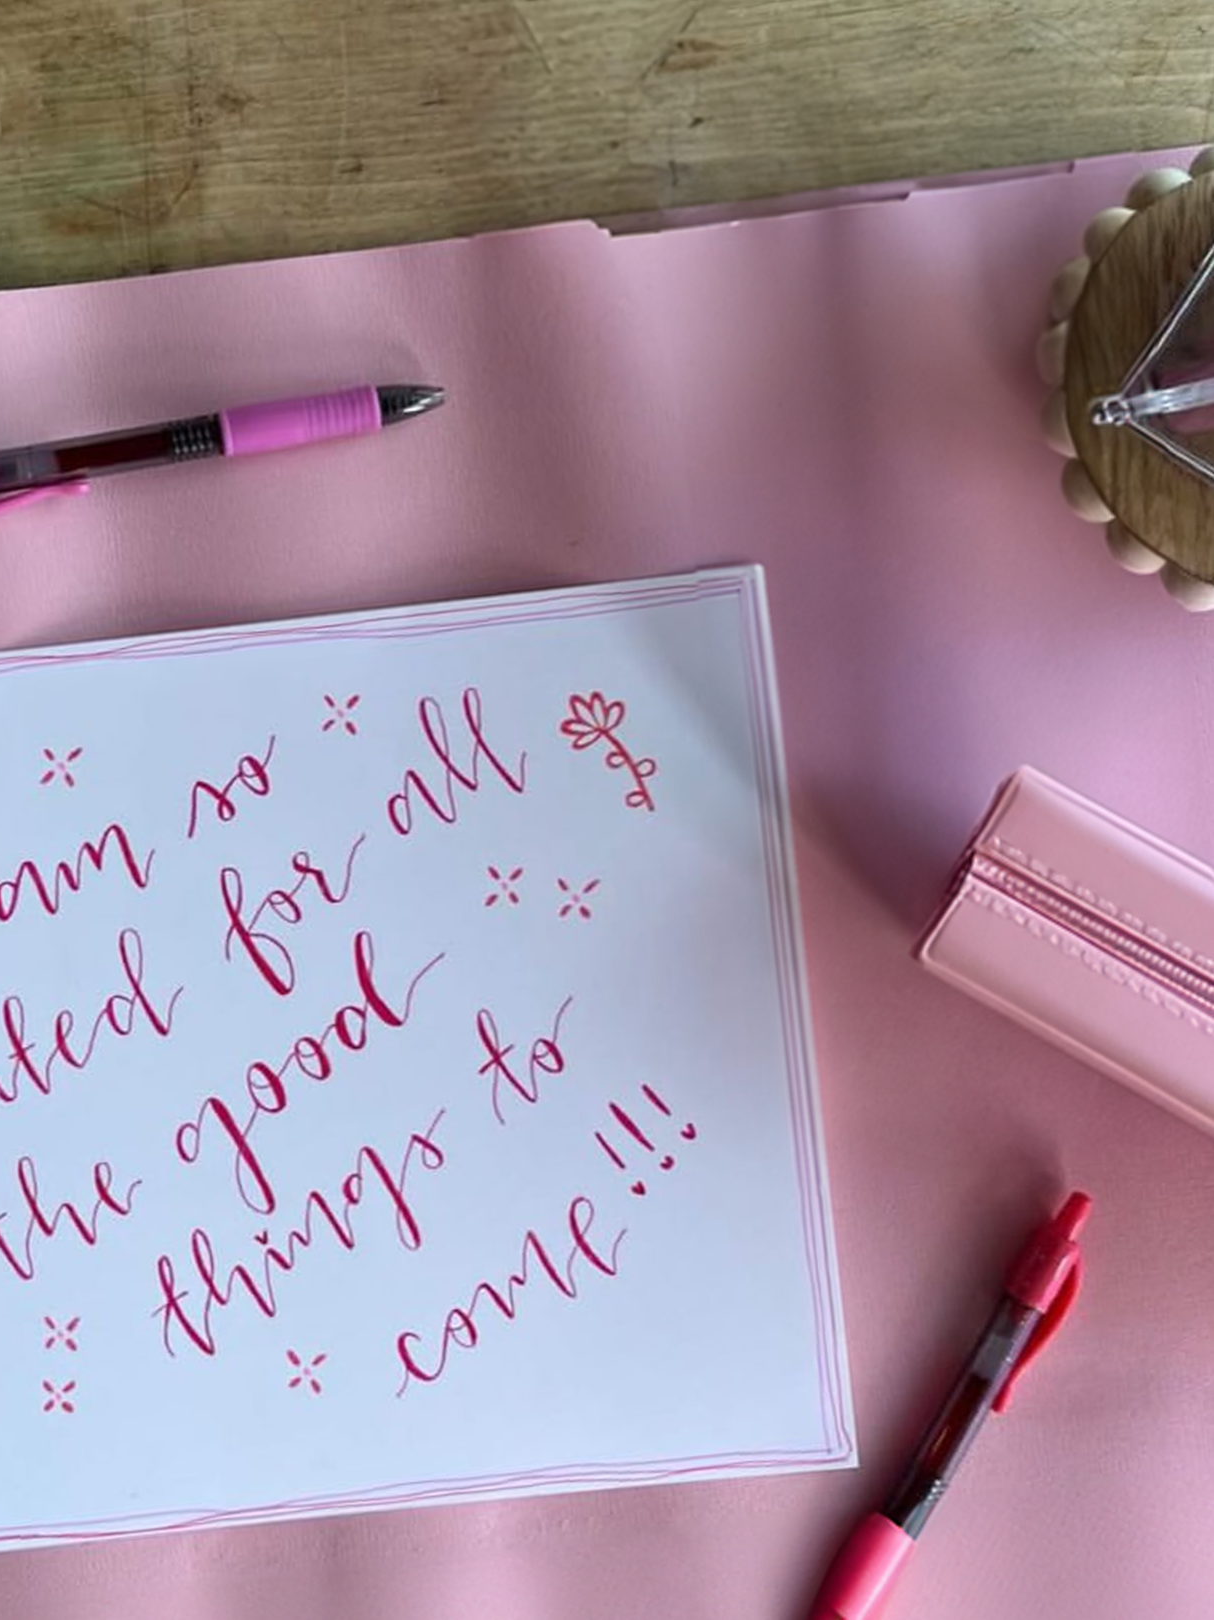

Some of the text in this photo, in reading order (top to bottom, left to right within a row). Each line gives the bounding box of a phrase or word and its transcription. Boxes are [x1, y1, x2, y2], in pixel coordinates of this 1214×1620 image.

[187, 735, 276, 839] so
[220, 833, 366, 997] for
[387, 687, 527, 836] all
[152, 995, 573, 1358] things to
[175, 931, 445, 1215] good
